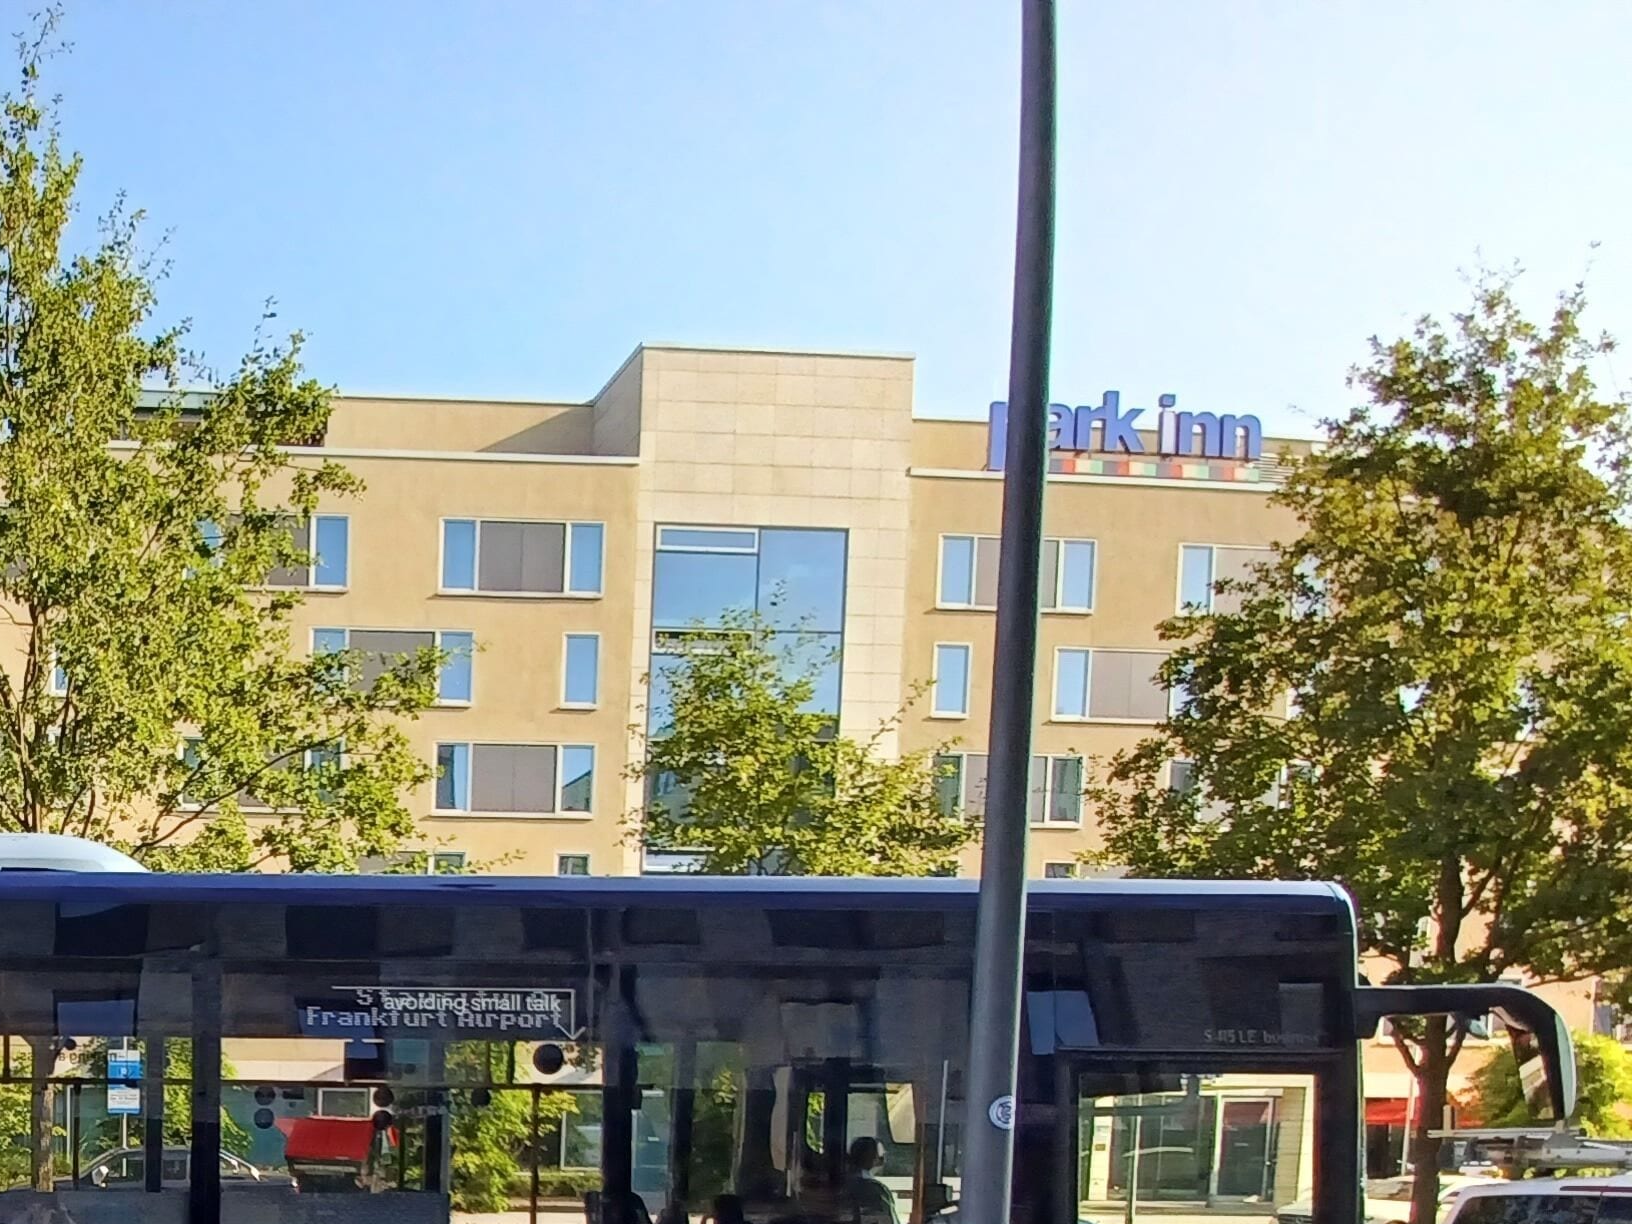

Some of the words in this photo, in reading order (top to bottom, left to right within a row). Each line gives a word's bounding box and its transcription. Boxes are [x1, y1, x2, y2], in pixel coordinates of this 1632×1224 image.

[1158, 393, 1262, 460] inn
[383, 992, 466, 1016] avoiding
[470, 992, 521, 1012] small
[525, 992, 561, 1012] talk
